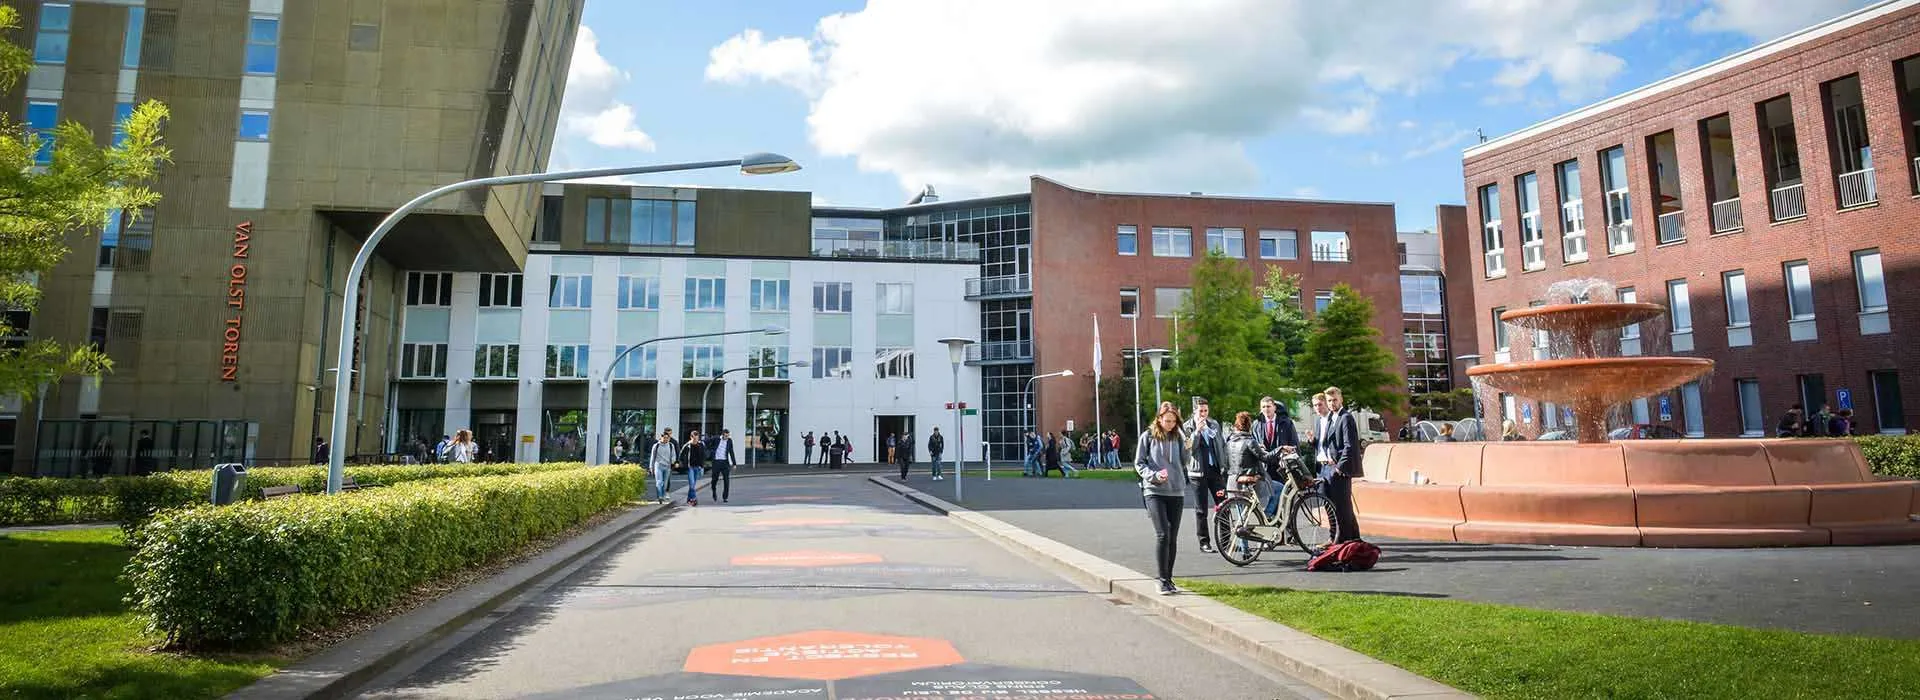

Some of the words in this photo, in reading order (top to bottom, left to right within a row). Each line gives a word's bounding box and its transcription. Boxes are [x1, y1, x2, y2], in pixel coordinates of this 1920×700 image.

[233, 221, 250, 258] VAN
[229, 265, 245, 310] OLST
[223, 316, 241, 381] TOREN
[732, 688, 822, 697] ACADEMIE
